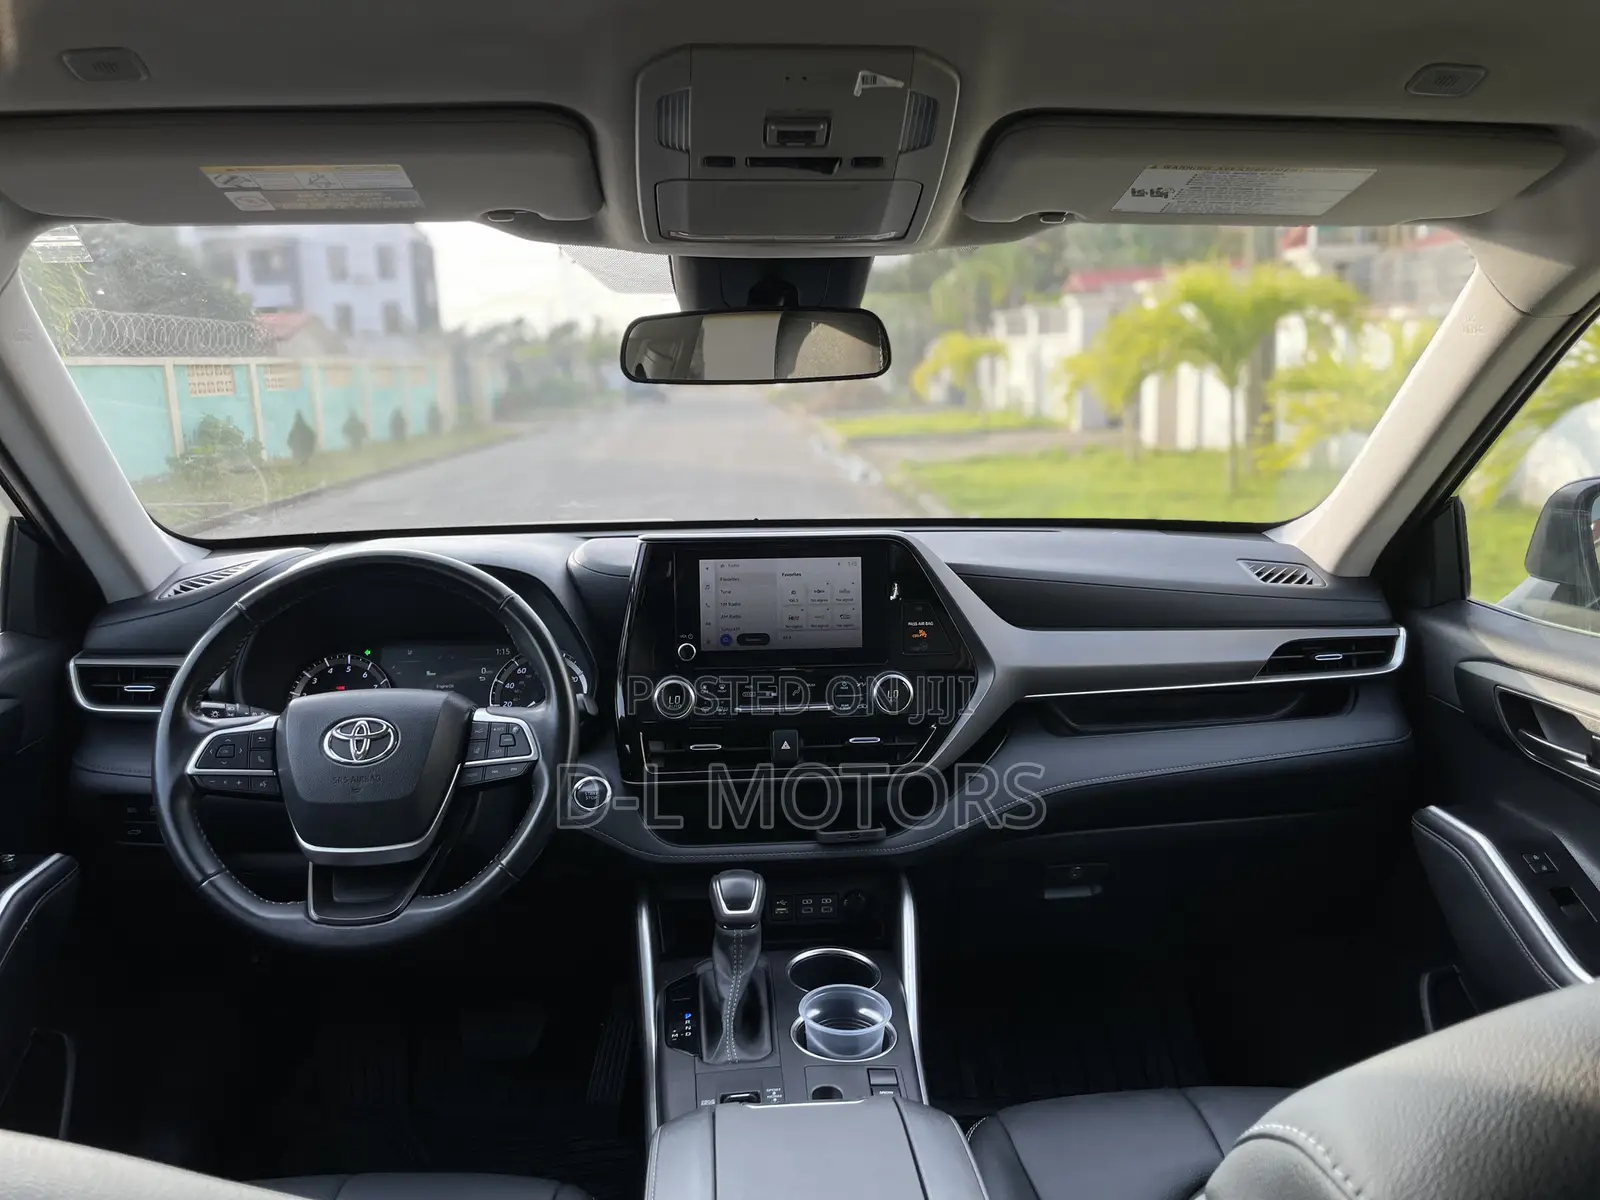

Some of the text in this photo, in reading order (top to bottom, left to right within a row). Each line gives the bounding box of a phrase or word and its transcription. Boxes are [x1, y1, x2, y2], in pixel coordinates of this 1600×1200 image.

[496, 648, 511, 656] 1:15
[346, 665, 352, 673] 5
[480, 667, 487, 675] 0
[516, 667, 527, 675] 60
[311, 677, 318, 685] 3
[504, 682, 515, 690] 40
[887, 689, 899, 699] LO
[668, 695, 681, 705] LO
